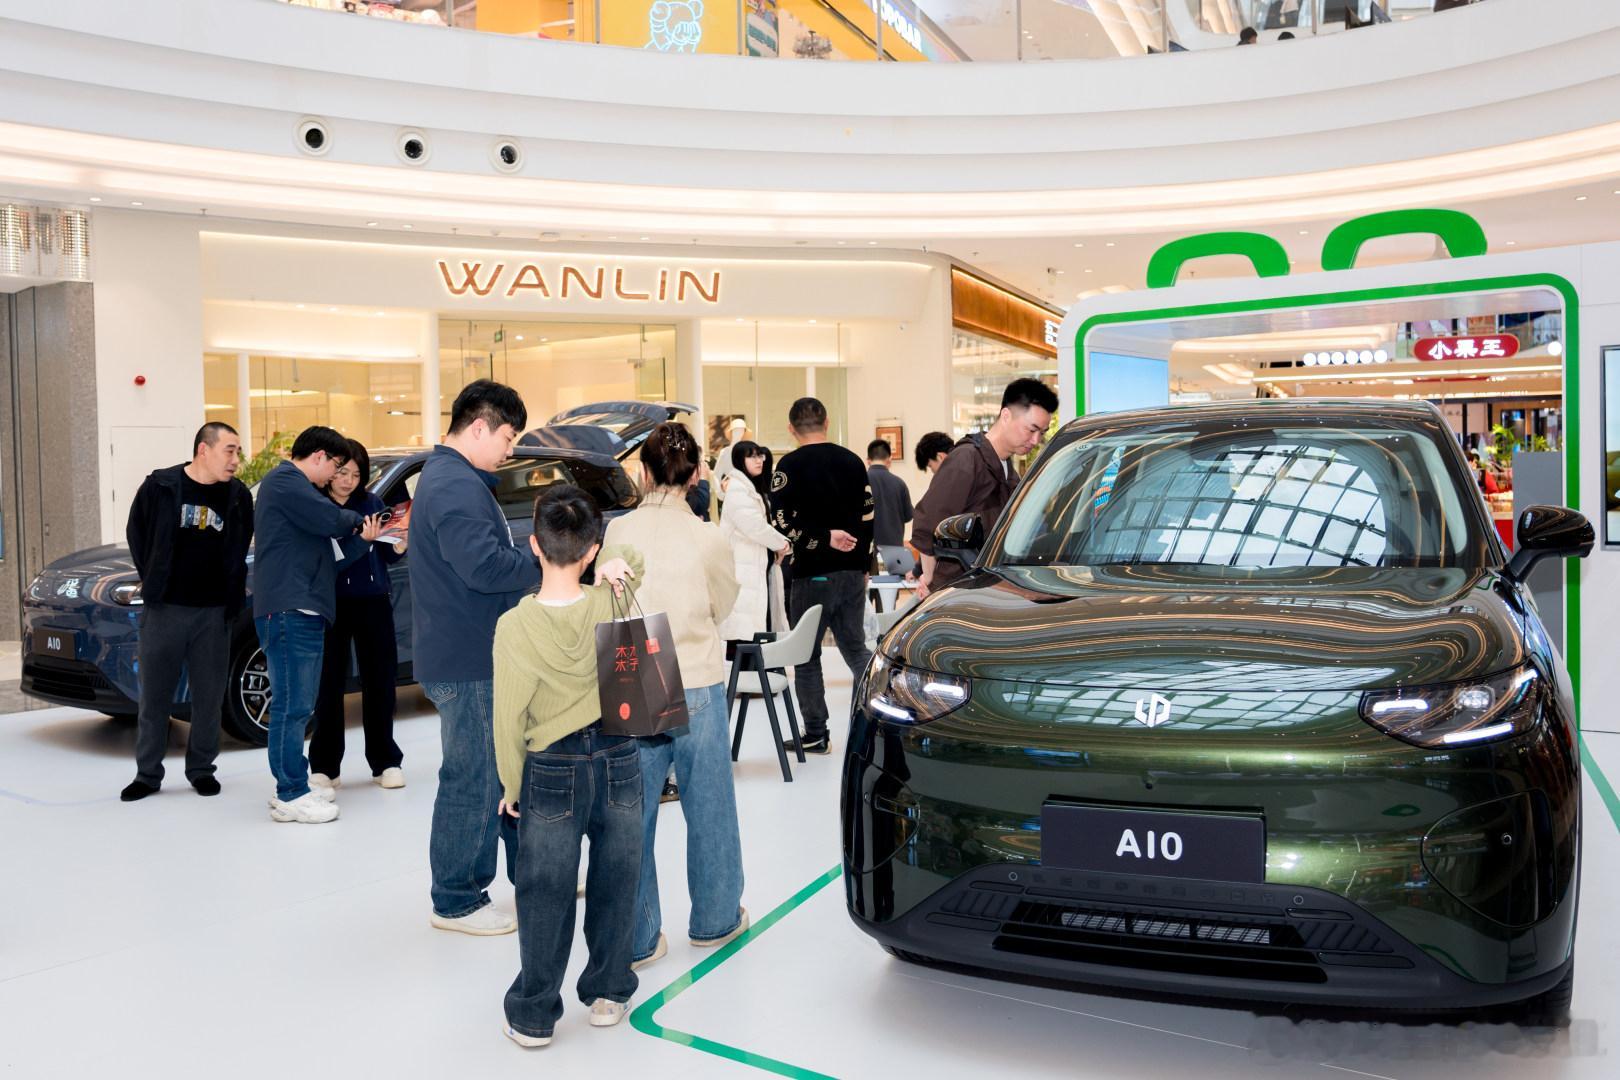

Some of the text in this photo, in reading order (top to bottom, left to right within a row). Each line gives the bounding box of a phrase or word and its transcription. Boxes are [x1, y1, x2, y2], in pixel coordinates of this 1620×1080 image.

[438, 260, 721, 303] WANLIN
[1428, 339, 1505, 360] 小果王
